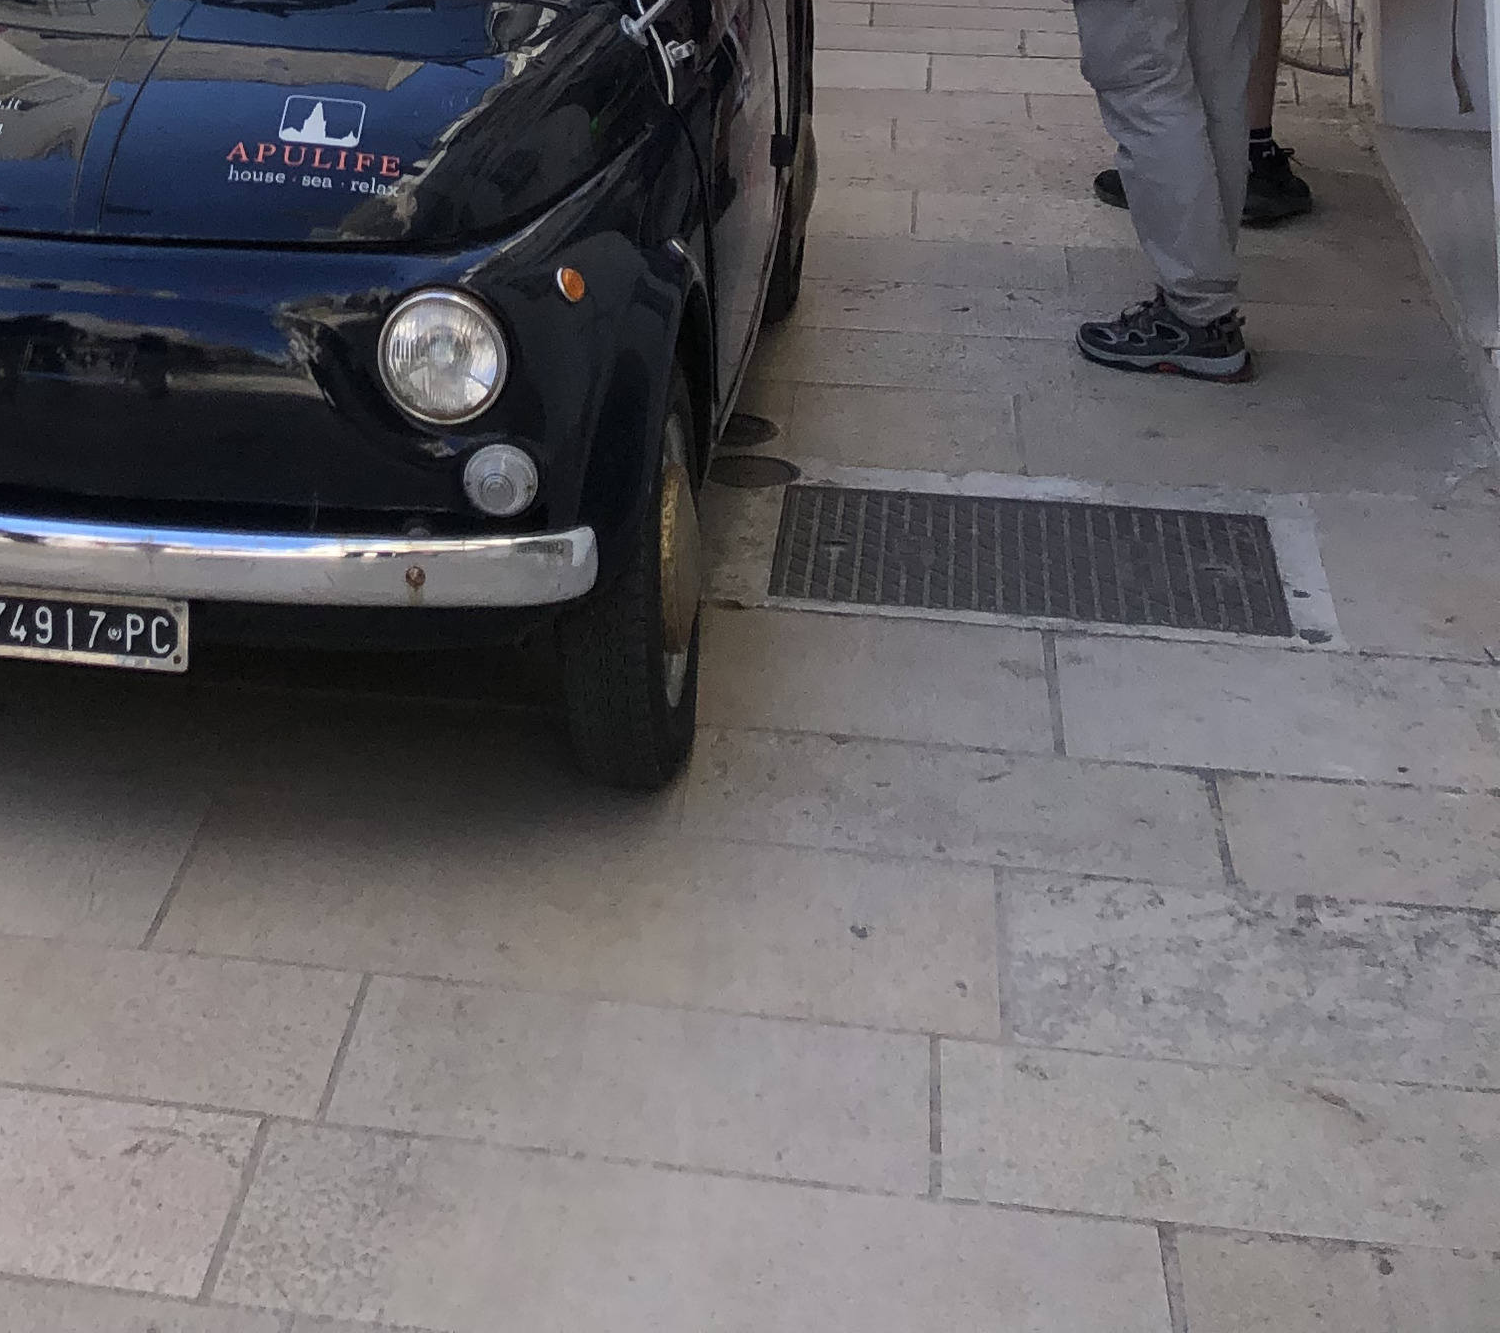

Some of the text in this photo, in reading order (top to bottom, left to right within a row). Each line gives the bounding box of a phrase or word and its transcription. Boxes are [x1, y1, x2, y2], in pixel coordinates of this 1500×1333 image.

[226, 142, 400, 177] APULIFE
[228, 164, 399, 197] house sea relax
[126, 613, 170, 654] PC
